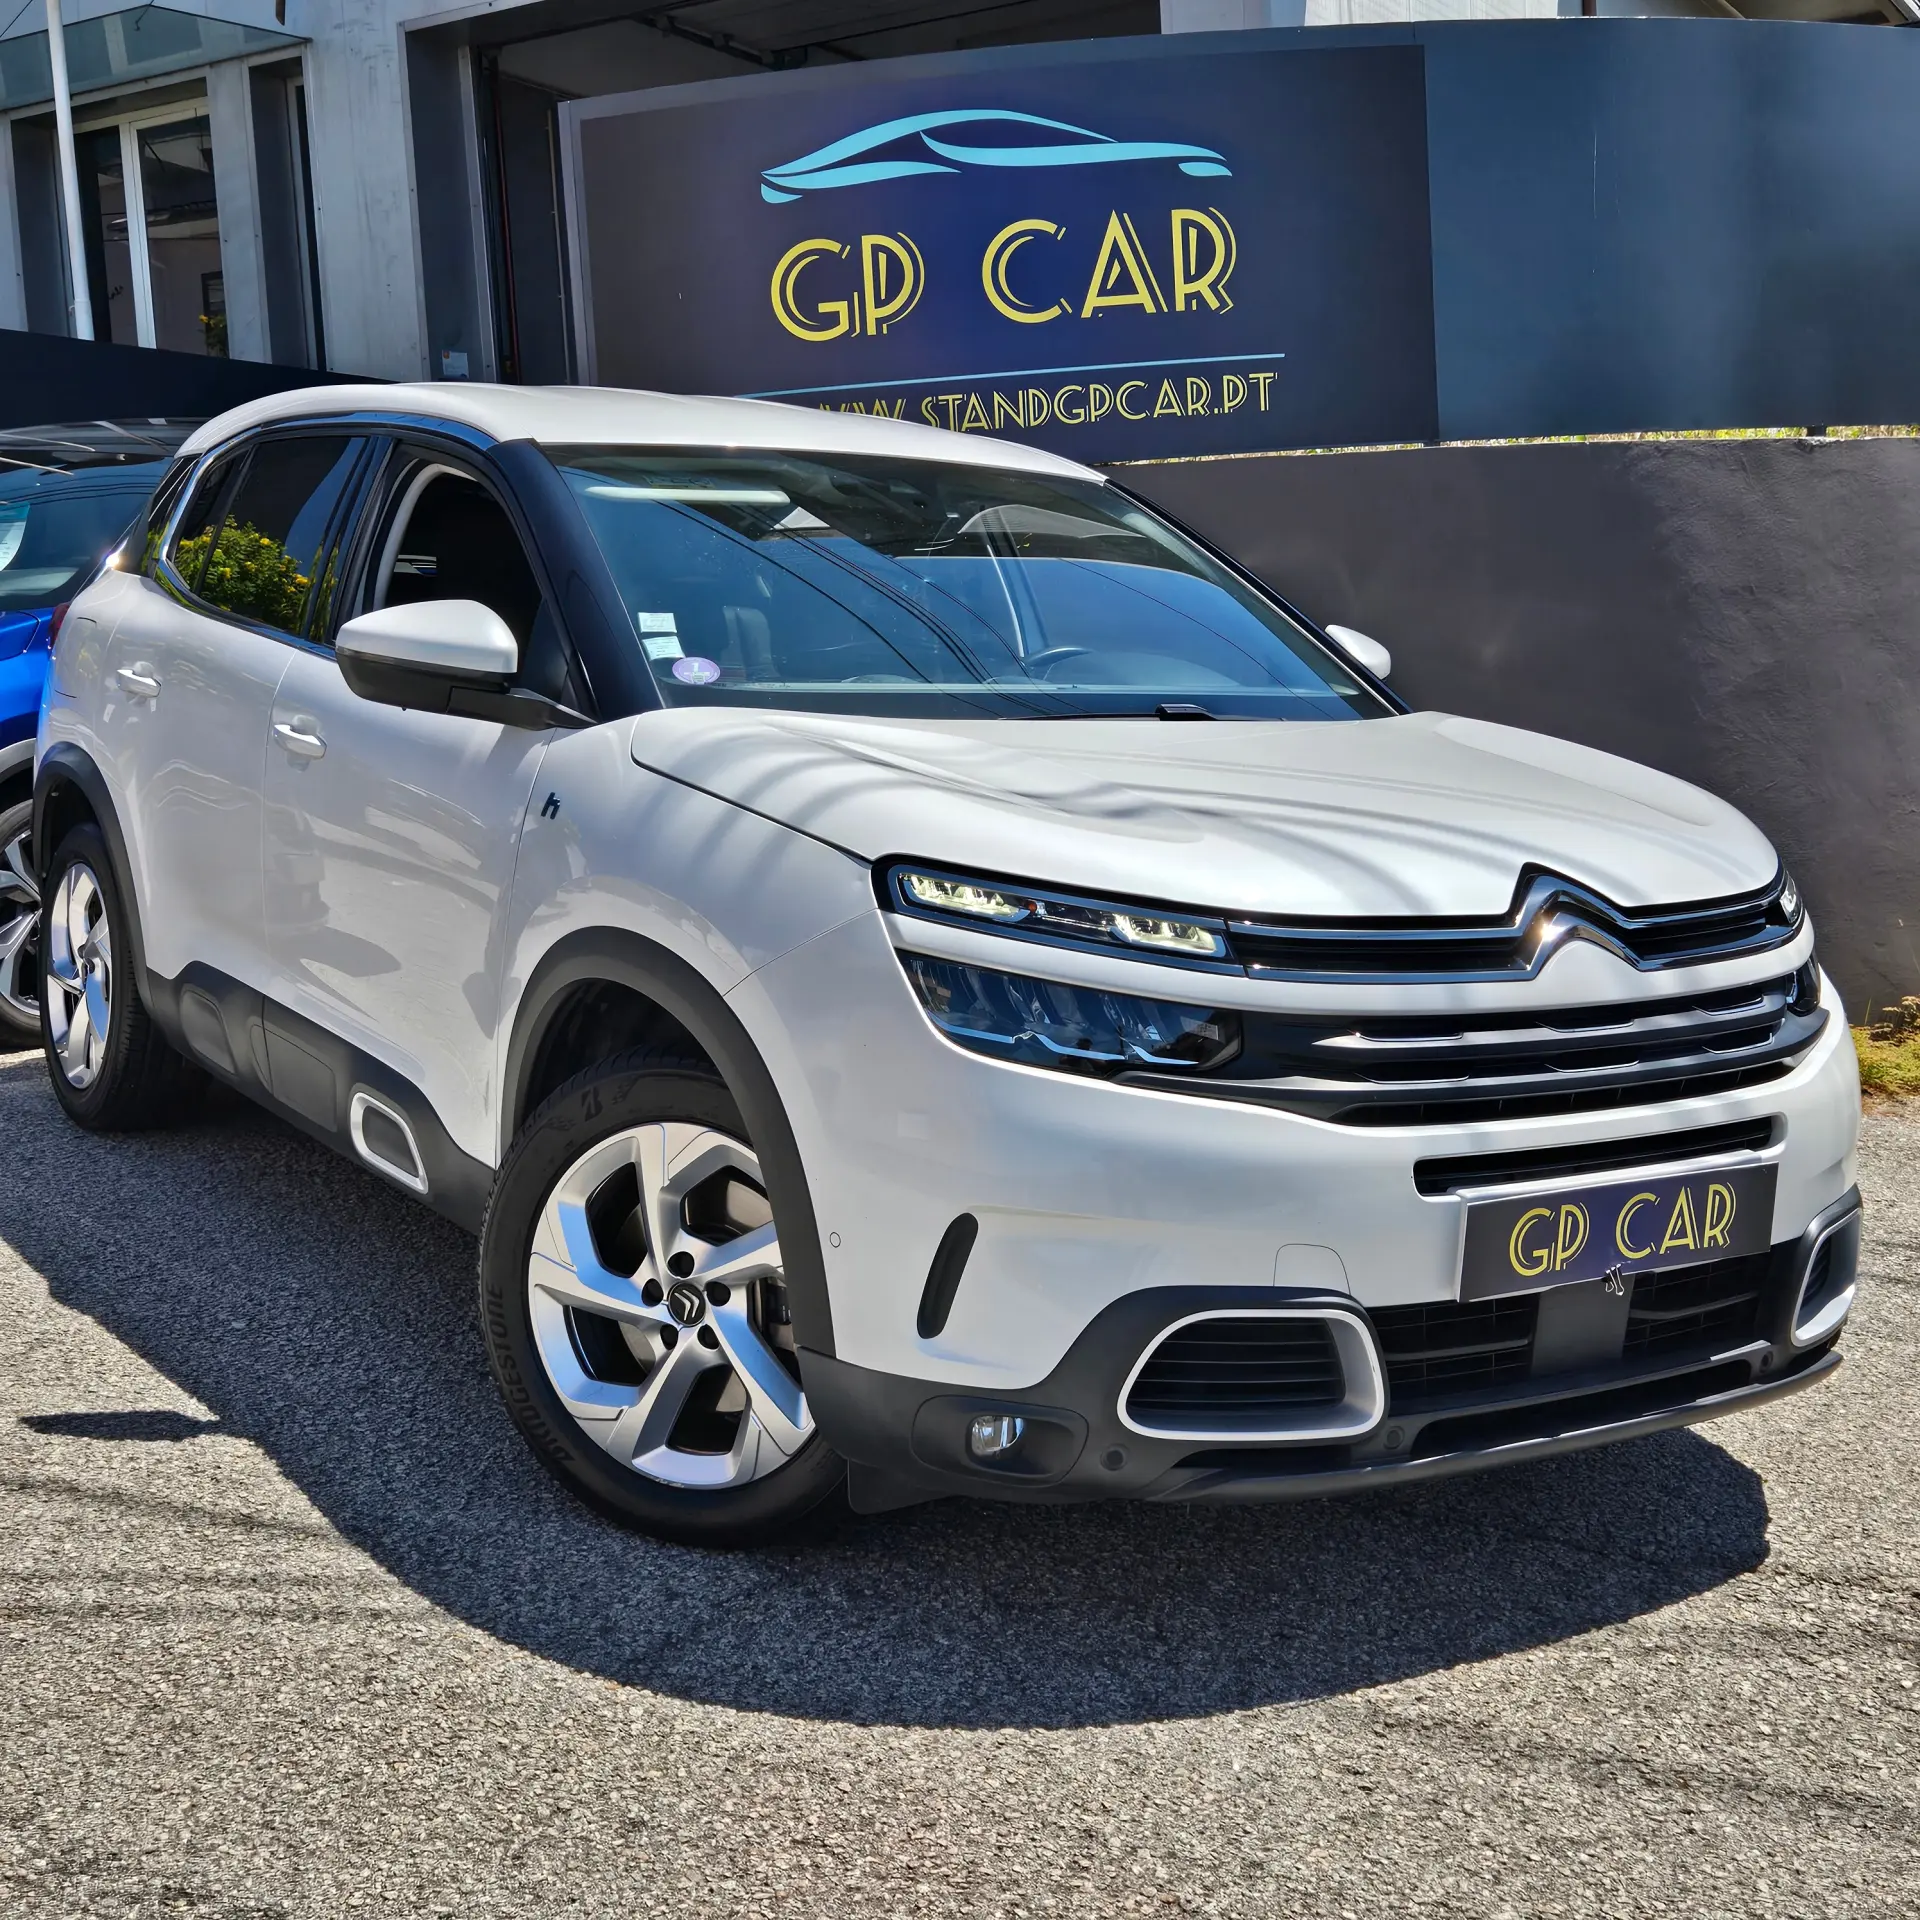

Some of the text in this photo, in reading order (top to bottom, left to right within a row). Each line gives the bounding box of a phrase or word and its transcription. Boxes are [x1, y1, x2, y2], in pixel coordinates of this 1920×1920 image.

[771, 207, 1237, 341] GP CAR
[819, 372, 1278, 432] STANDGPCAR.PT
[1509, 1182, 1737, 1277] GP CAR
